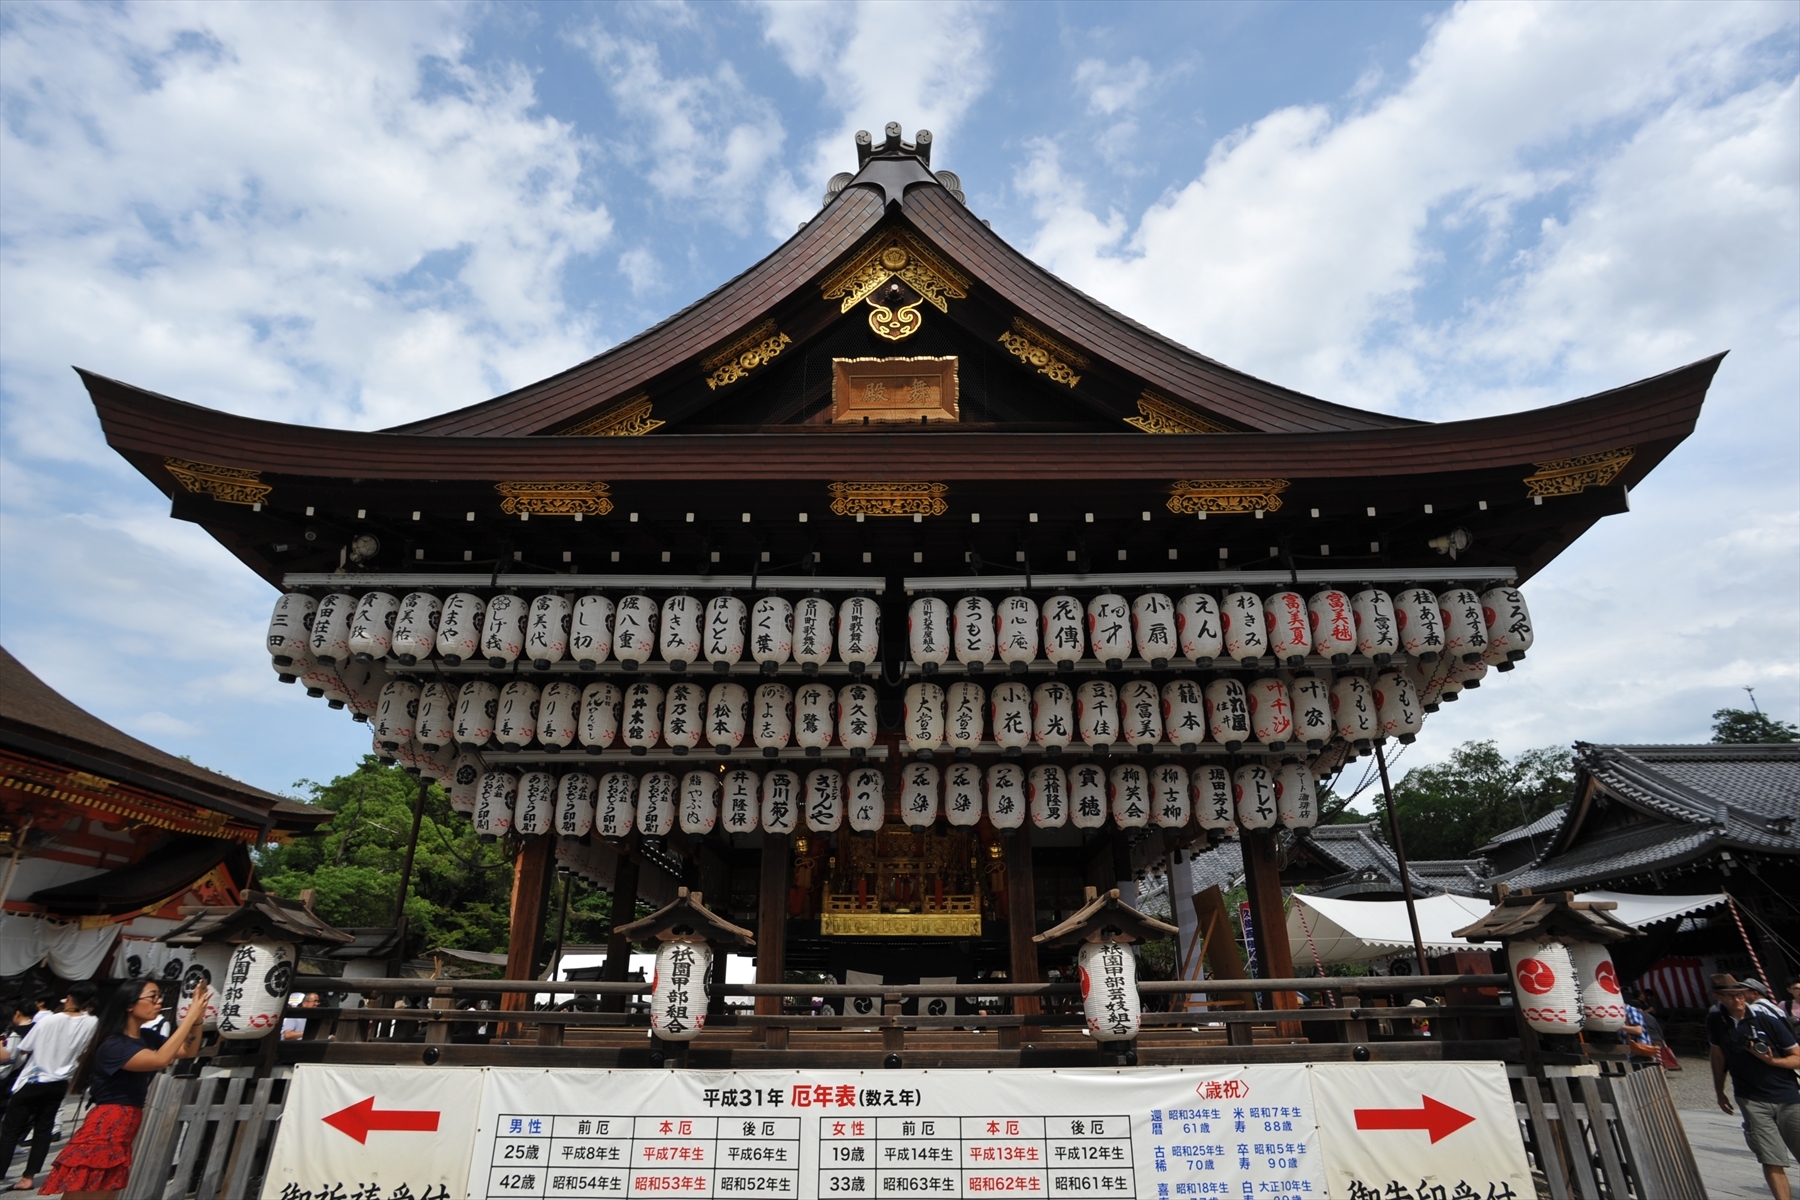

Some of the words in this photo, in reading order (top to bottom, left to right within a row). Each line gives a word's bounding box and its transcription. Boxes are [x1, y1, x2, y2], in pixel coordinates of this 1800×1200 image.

[861, 379, 931, 405] 舞殿
[270, 614, 289, 647] 三田
[312, 595, 339, 648] 家田荘子
[440, 594, 463, 642] たまや
[530, 596, 553, 647] 富美代
[573, 597, 597, 649] いし初
[619, 597, 640, 648] 堀八重
[667, 597, 685, 648] 利きみ
[755, 600, 775, 654] ふく葉
[801, 598, 818, 655] 宮川町歌舞会
[847, 598, 865, 654] 宮川町歌舞会
[966, 597, 982, 651] まつもと
[1145, 597, 1169, 645] 小扇
[1195, 596, 1217, 639] えん
[1236, 595, 1262, 647] 杉きみ
[1282, 593, 1309, 646] 富美夏
[1412, 591, 1441, 646] 桂あす香
[1457, 591, 1487, 647] 桂あす香
[849, 686, 869, 735] 富久家
[1003, 687, 1024, 735] 小花
[1043, 684, 1067, 737] 市光
[1091, 683, 1111, 736] 豆千佳
[1133, 684, 1156, 738] 久富美
[1299, 681, 1325, 727] 叶家
[1350, 678, 1369, 731] ちもと
[1392, 674, 1413, 724] ちもと
[712, 703, 732, 736] 松本
[476, 772, 495, 830] あおぞら印刷
[521, 774, 541, 832] あおぞら印刷
[561, 774, 580, 832] あおぞら印刷
[602, 775, 620, 834] あおぞら印刷
[643, 775, 661, 833] あおぞら印刷
[729, 771, 749, 827] 井上隆保
[1122, 767, 1145, 819] 柳笑会
[1162, 768, 1182, 821] 柳古柳
[1208, 768, 1230, 822] 堀田芳史
[1251, 767, 1273, 820] カトレヤ
[1295, 765, 1310, 819] スマート珈琲店
[219, 946, 256, 1032] 祇園甲部組合
[663, 945, 695, 1034] 祇園甲部組合
[1101, 944, 1131, 1035] 祇園甲部芸妓組合
[703, 1088, 784, 1108] 平成31年
[791, 1084, 856, 1108] 厄年表
[859, 1088, 921, 1108] (数え年)
[509, 1119, 542, 1134] 男性
[578, 1120, 610, 1136] 前厄
[659, 1121, 693, 1136] 本厄
[743, 1121, 775, 1136] 後厄
[832, 1121, 865, 1136] 女性
[902, 1120, 935, 1136] 前厄
[986, 1120, 1020, 1136] 本厄
[1071, 1120, 1105, 1135] 後厄
[1169, 1108, 1221, 1120] 昭和34年生
[1183, 1122, 1210, 1134] 61歳
[1249, 1107, 1302, 1119] 昭和7年生
[1264, 1121, 1293, 1132] 88歳
[504, 1144, 540, 1160] 25歳
[561, 1145, 620, 1160] 平成8年生
[643, 1146, 704, 1161] 平成7年生
[727, 1146, 787, 1162] 平成6年生
[832, 1146, 865, 1162] 19歳
[884, 1146, 953, 1161] 平成14年生
[970, 1146, 1040, 1161] 平成13年生
[1055, 1146, 1125, 1161] 平成12年生
[1171, 1145, 1225, 1157] 昭和25年生
[1186, 1159, 1215, 1171] 70歳
[1254, 1143, 1307, 1155] 昭和5年生
[1268, 1157, 1298, 1169] 90歳
[499, 1174, 535, 1190] 42歳
[552, 1175, 622, 1191] 昭和54年生
[635, 1176, 706, 1191] 昭和53年生
[720, 1176, 791, 1192] 昭和52年生
[829, 1176, 865, 1192] 33歳
[883, 1176, 955, 1191] 昭和63年生
[969, 1176, 1041, 1191] 昭和62年生
[1055, 1175, 1128, 1191] 昭和61年生
[1157, 1183, 1170, 1200] 喜
[1176, 1182, 1230, 1195] 昭和18年生
[1258, 1180, 1312, 1192] 大正10年生
